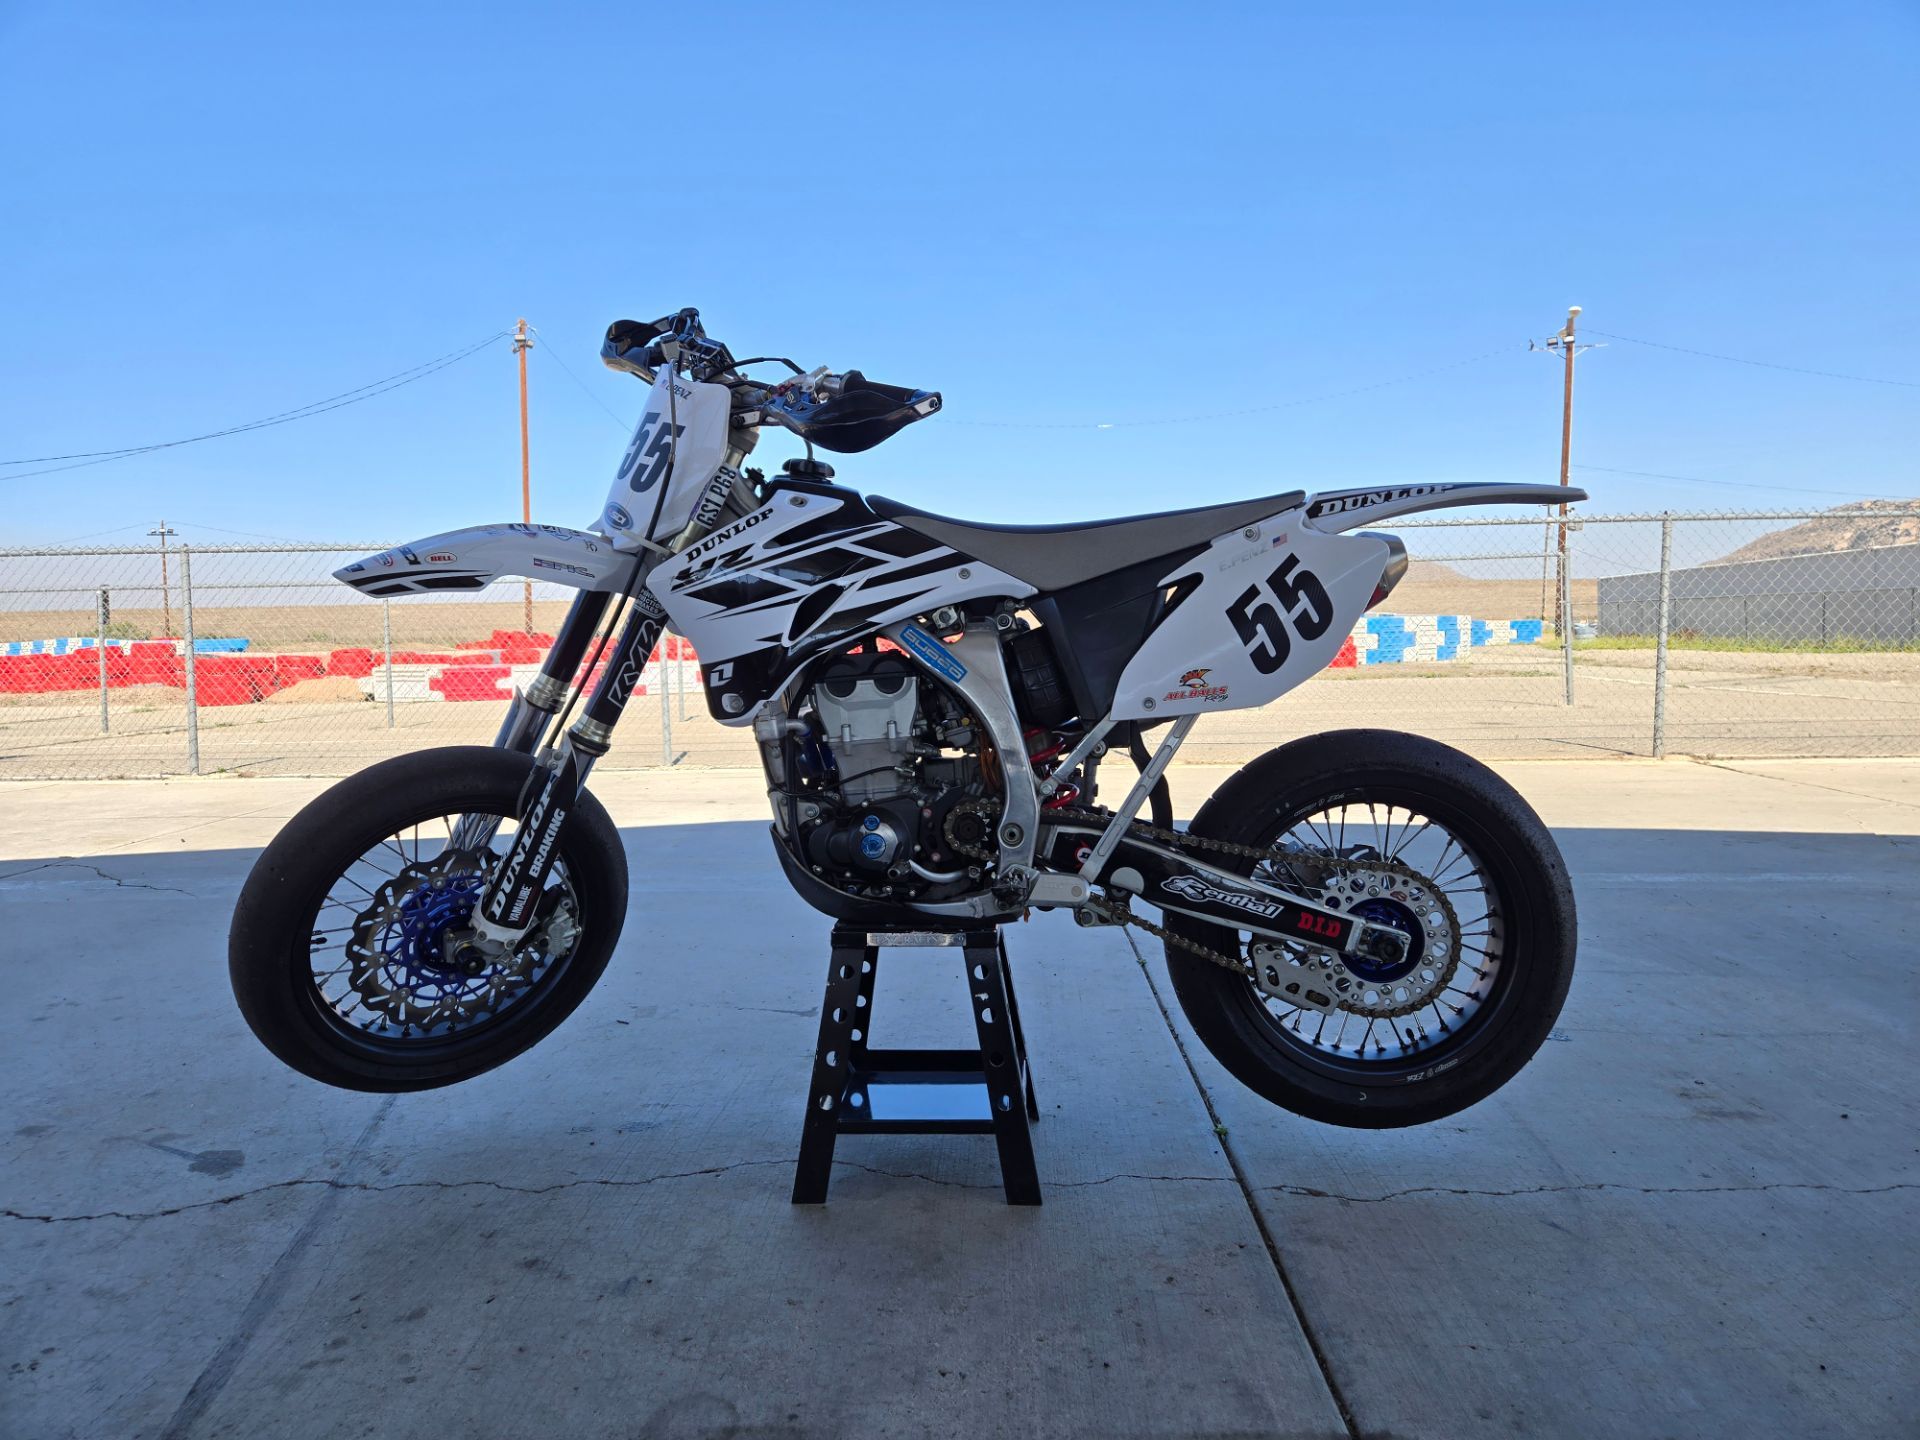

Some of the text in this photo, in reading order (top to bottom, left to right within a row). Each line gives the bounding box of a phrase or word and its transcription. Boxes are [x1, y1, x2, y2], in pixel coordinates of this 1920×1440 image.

[617, 411, 686, 493] 55
[1318, 484, 1454, 517] DUNLOP
[685, 507, 774, 563] DUNLOP
[1226, 552, 1334, 675] 55
[491, 777, 554, 920] DUNLOP
[528, 807, 566, 879] BRAKING
[508, 885, 532, 921] YAMALUBE
[1162, 875, 1283, 917] Renthal
[1297, 911, 1341, 938] D.I.D
